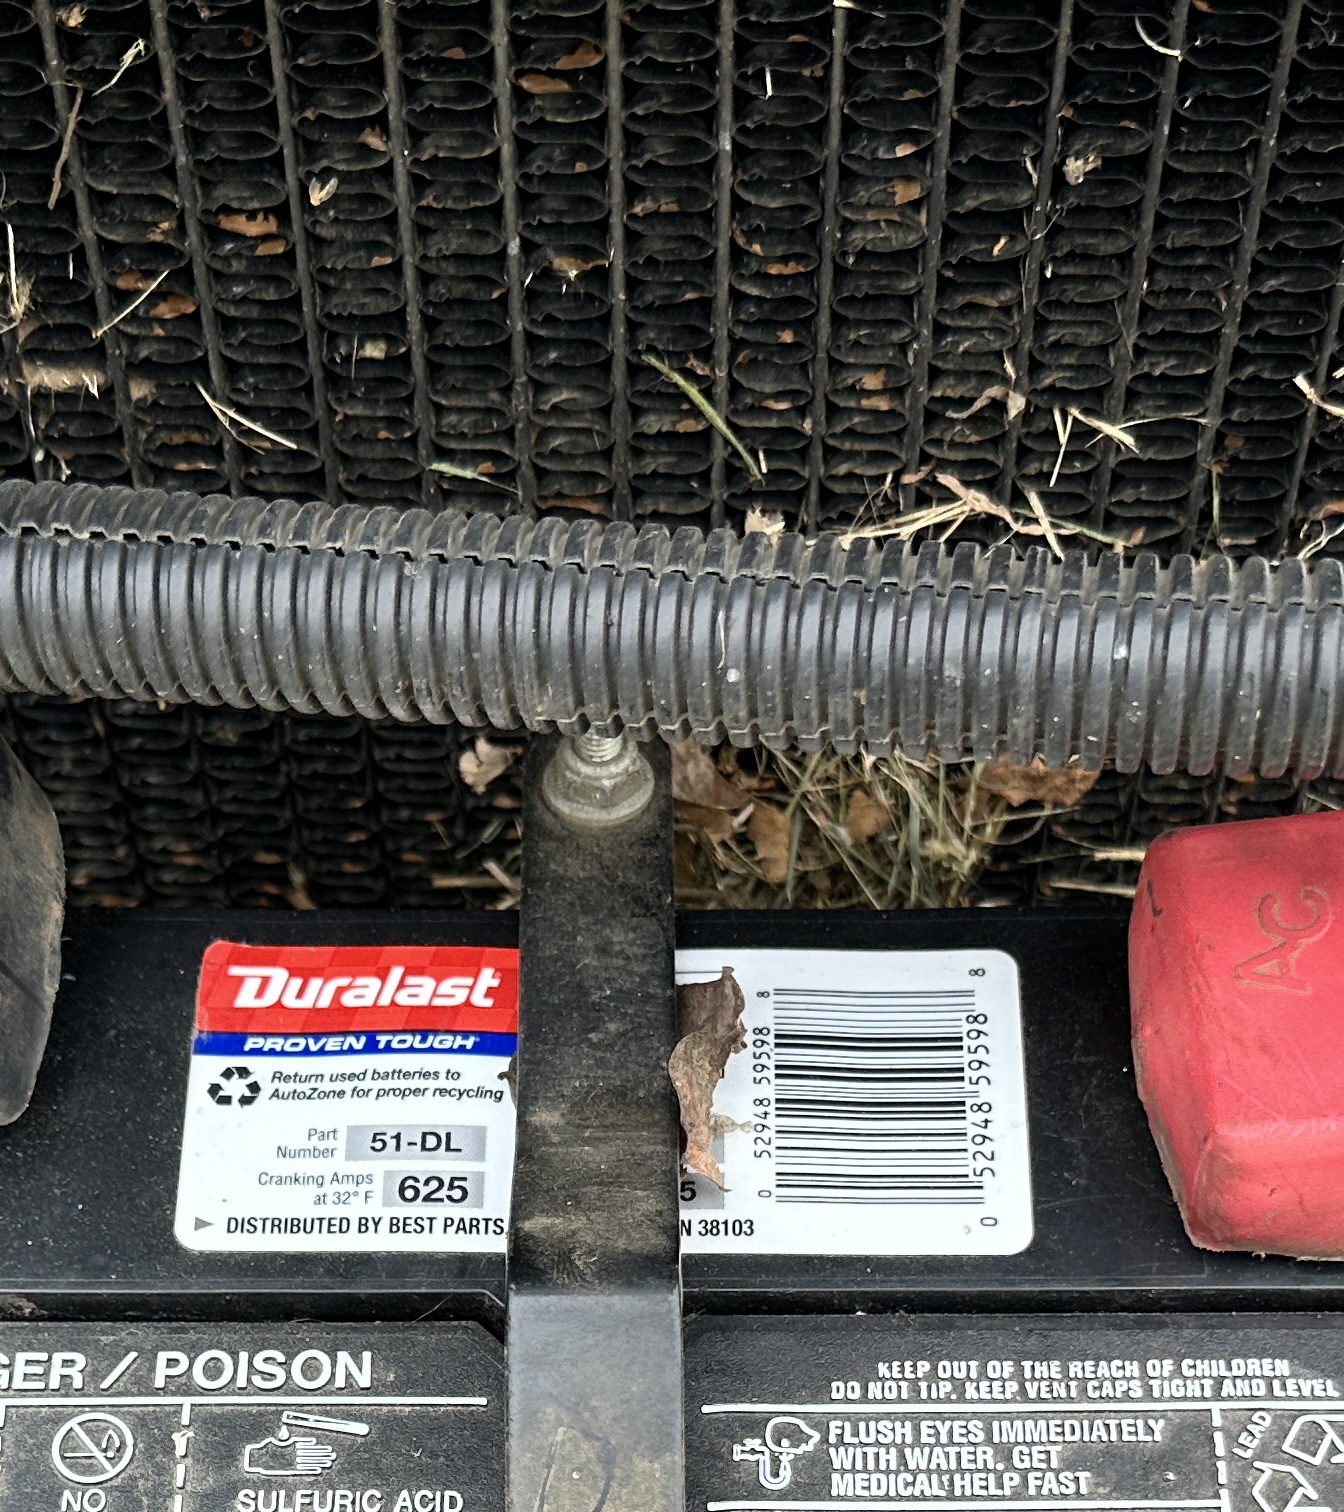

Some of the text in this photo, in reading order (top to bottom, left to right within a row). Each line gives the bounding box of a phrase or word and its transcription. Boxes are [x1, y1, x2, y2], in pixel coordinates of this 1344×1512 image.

[227, 965, 501, 1009] Duralast
[755, 990, 771, 999] 8
[244, 1034, 476, 1052] PROVEN TOUGH
[752, 1026, 772, 1086] 59598
[271, 1067, 461, 1084] Return used batteries to
[268, 1085, 505, 1103] AutoZone for proper recycling
[965, 968, 999, 1227] 0 52948 59598 8
[307, 1128, 339, 1142] Part
[753, 1097, 772, 1160] 52948
[276, 1145, 338, 1159] Number
[369, 1131, 463, 1153] 51-DL
[257, 1171, 374, 1188] Cranking Amps
[397, 1175, 469, 1204] 625
[313, 1193, 328, 1206] at
[364, 1191, 374, 1204] F
[226, 1216, 351, 1235] DISTRIBUTED
[357, 1216, 384, 1234] BY
[388, 1216, 438, 1235] BEST
[697, 1219, 755, 1237] 38103
[153, 1349, 373, 1390] POISON
[877, 1358, 1290, 1379] KEEP OUT OF THE REACH OF CHILDREN
[830, 1378, 1340, 1400] DO NOT TIP. KEEP VENT CAPS TIGHT AND LEVEL
[828, 1418, 1165, 1445] FLUSH EYES IMMEDIATELY
[1232, 1410, 1272, 1459] LEAD
[828, 1445, 1062, 1471] WITH WATER. GET
[830, 1471, 1091, 1497] MEDICAL HELP FAST
